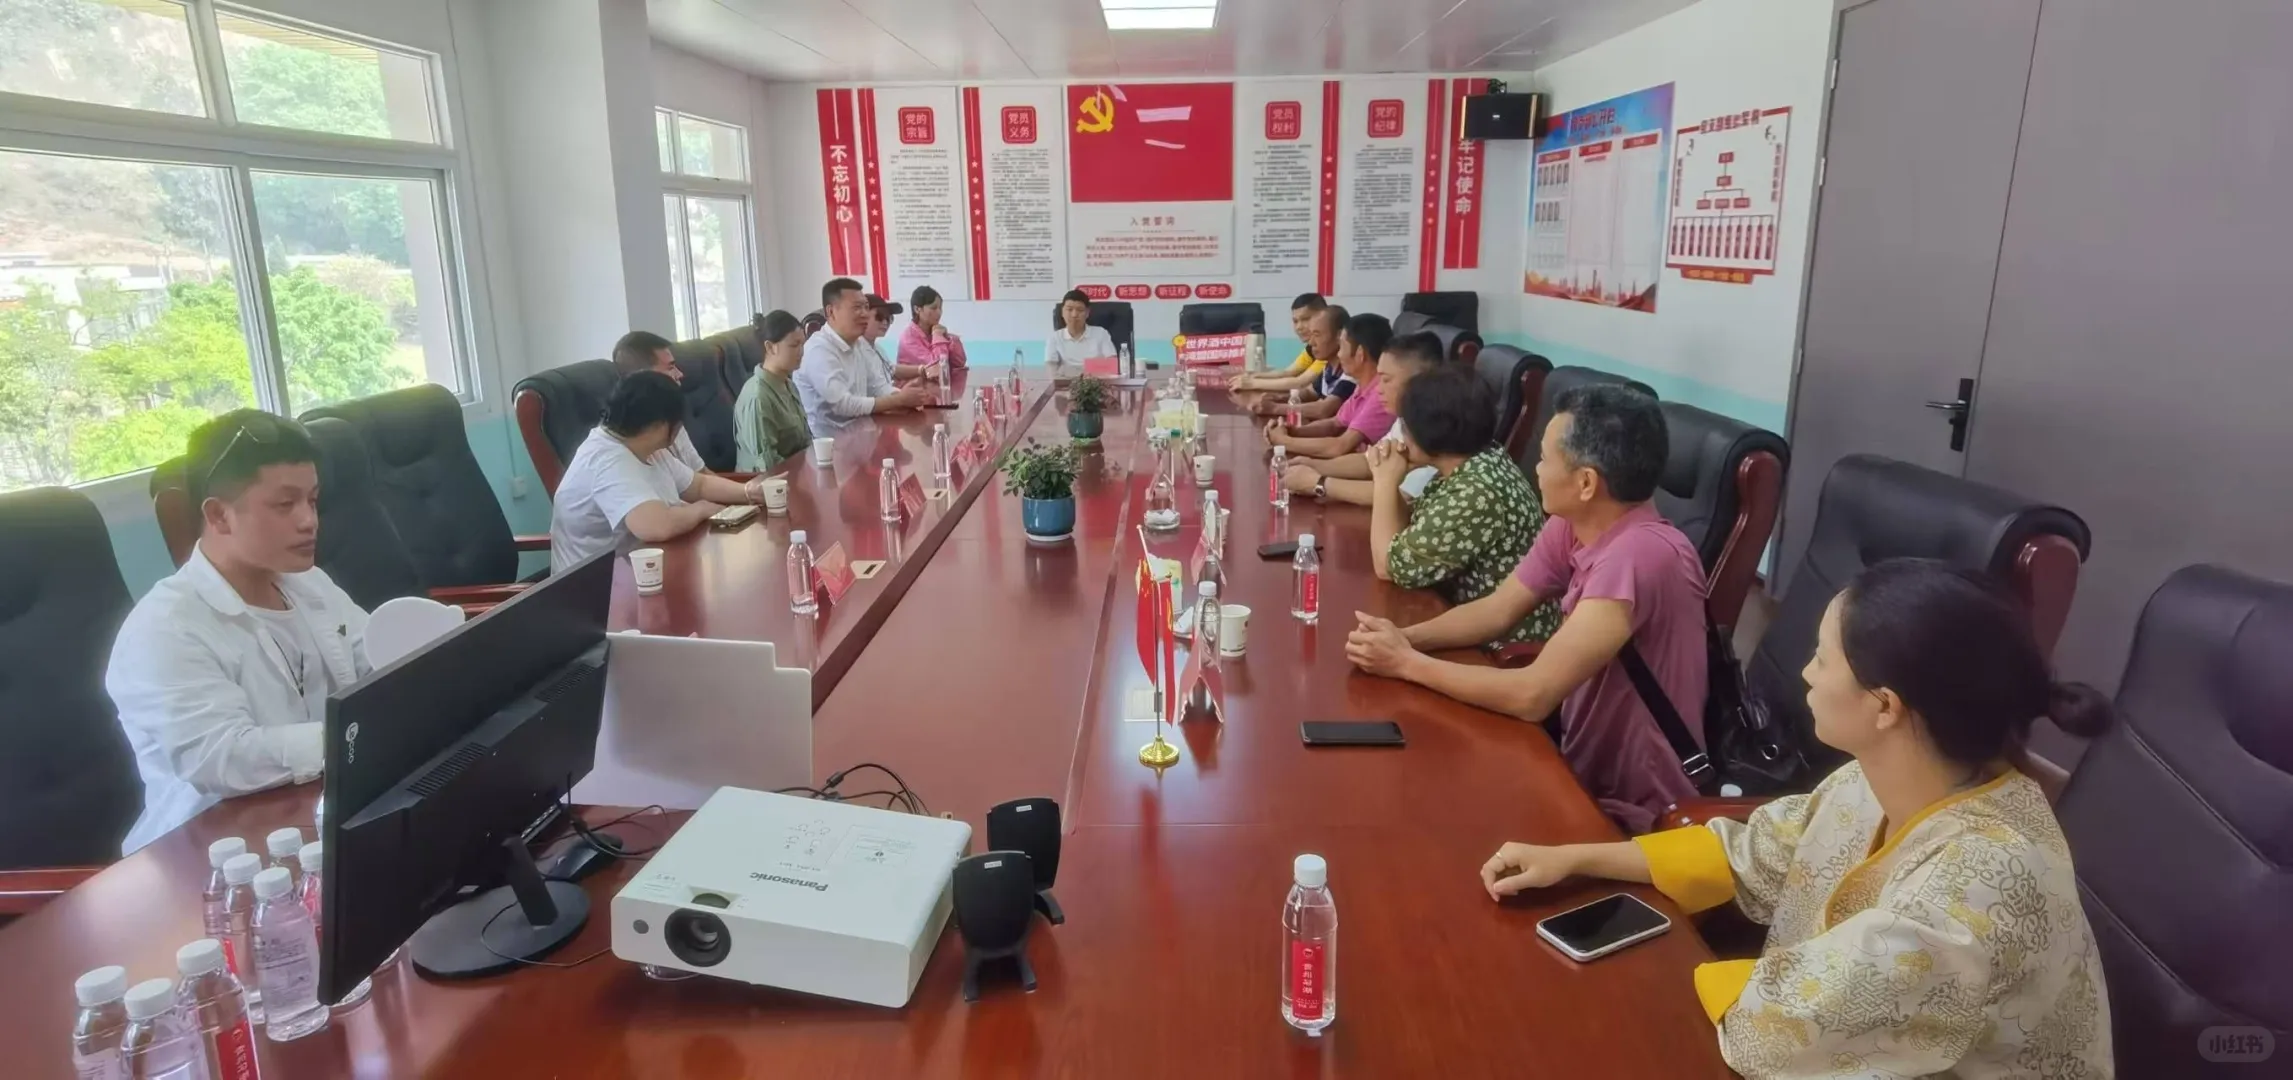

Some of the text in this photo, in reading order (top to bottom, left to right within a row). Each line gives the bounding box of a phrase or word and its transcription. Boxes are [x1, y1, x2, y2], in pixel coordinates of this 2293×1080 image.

[905, 113, 927, 125] 党的
[1008, 112, 1029, 125] 党员
[905, 126, 928, 139] 宗旨
[1009, 126, 1030, 138] 义务
[830, 144, 853, 222] 不忘初心
[1118, 286, 1148, 297] 新思想
[1186, 335, 1246, 349] 世界酒中国
[749, 872, 829, 892] Panasonic
